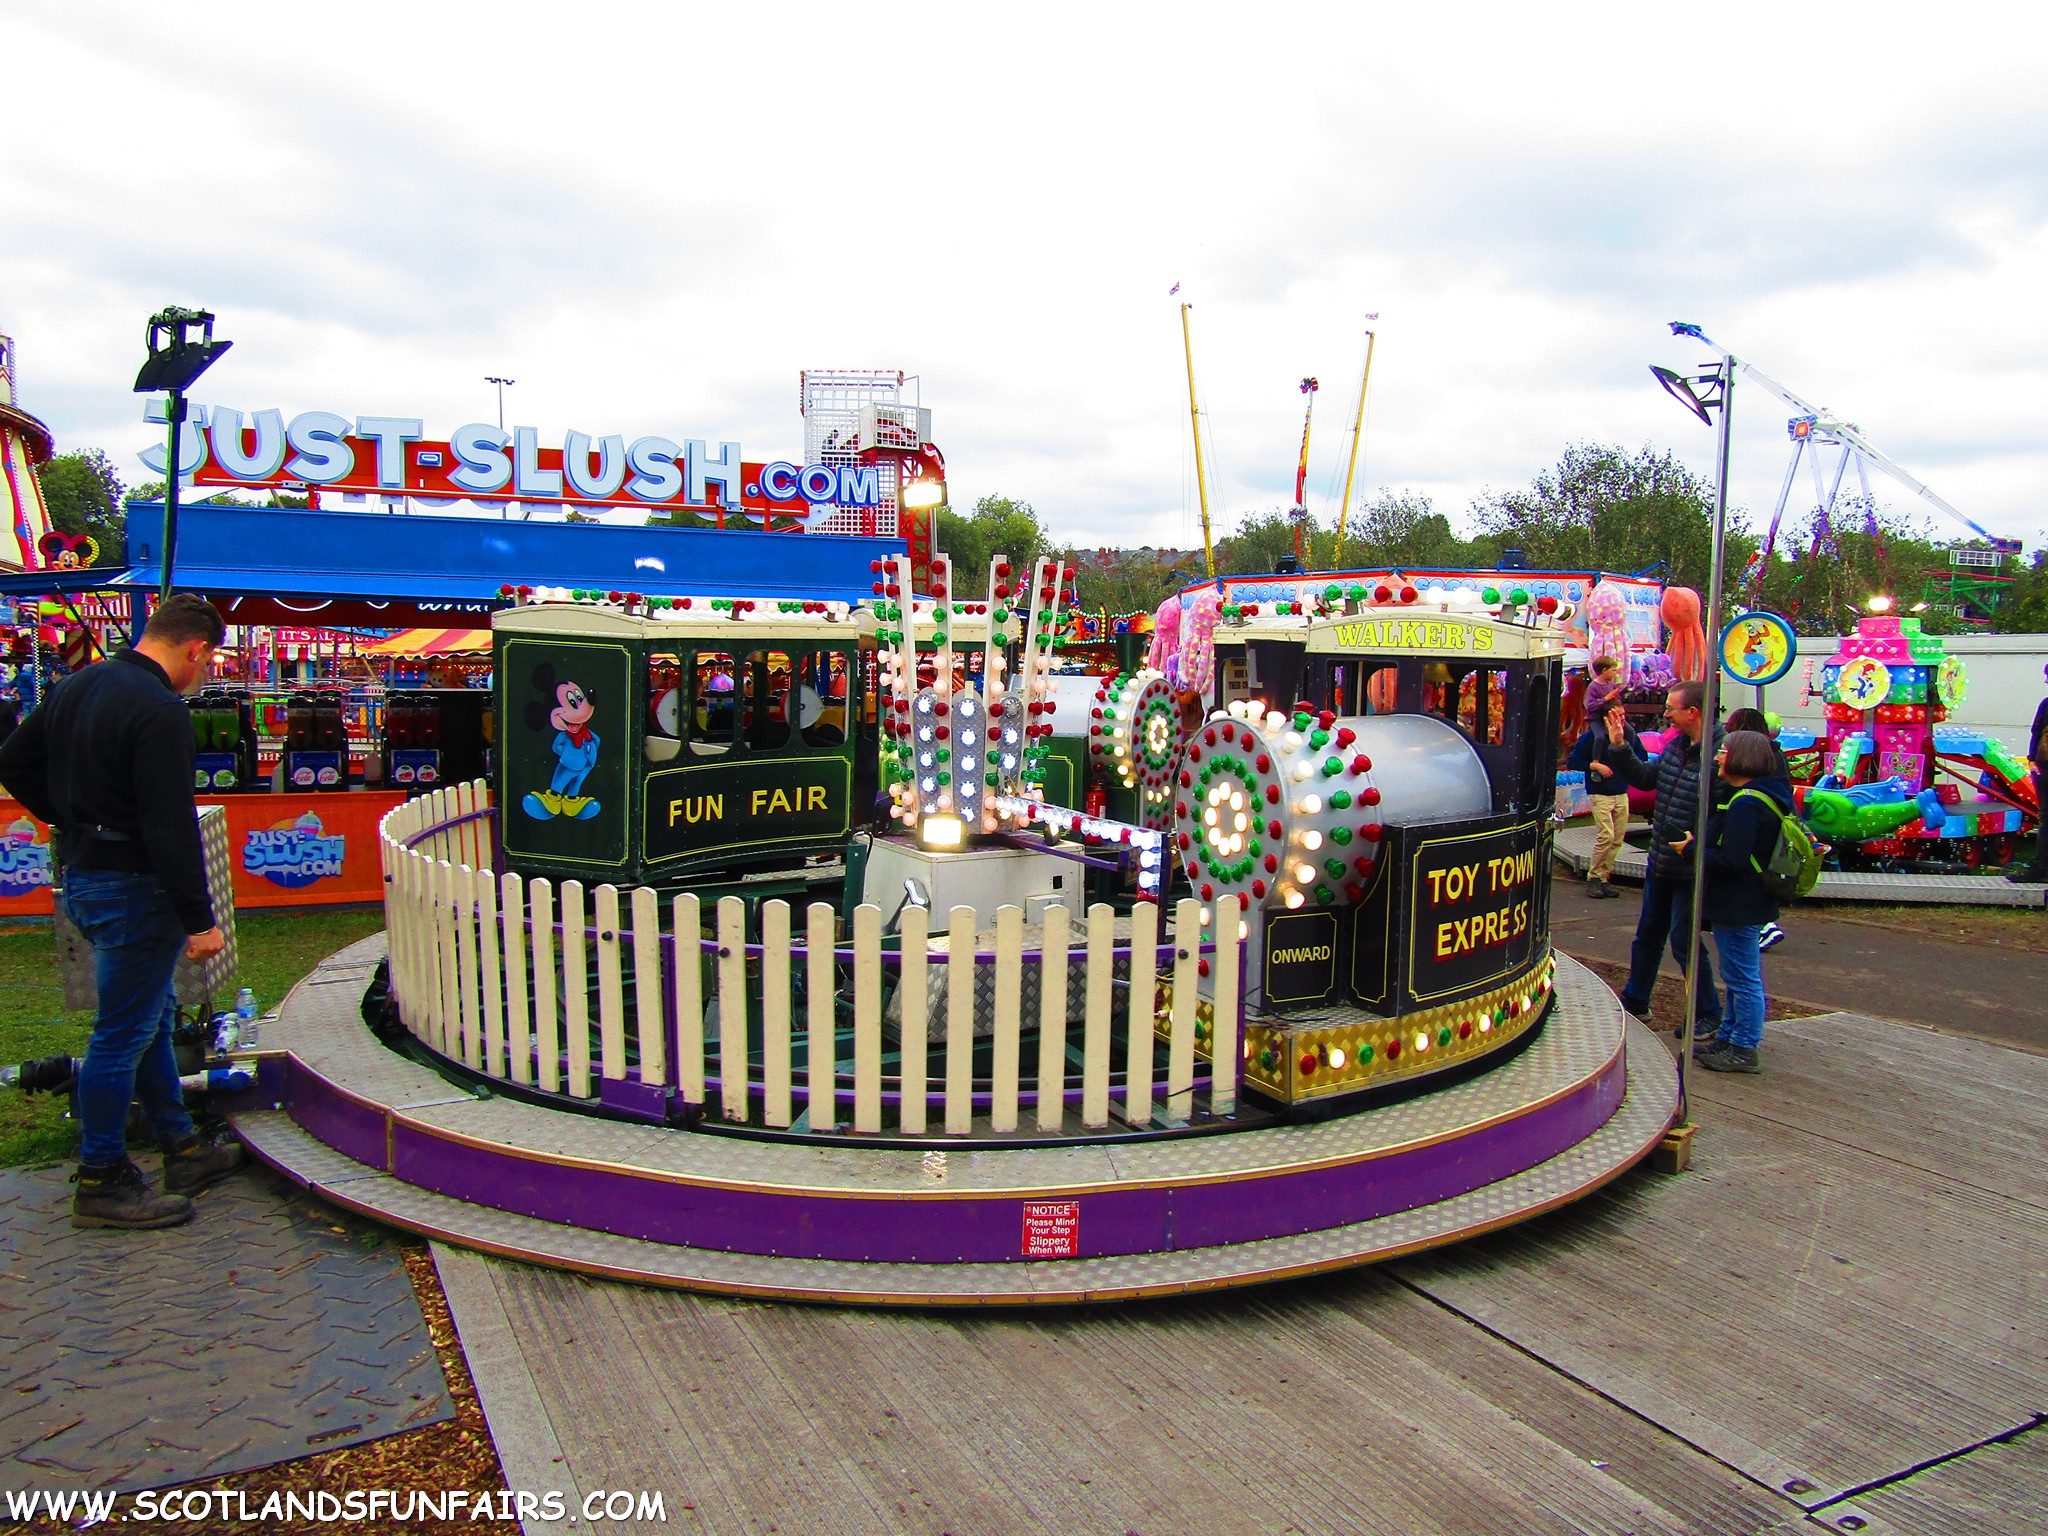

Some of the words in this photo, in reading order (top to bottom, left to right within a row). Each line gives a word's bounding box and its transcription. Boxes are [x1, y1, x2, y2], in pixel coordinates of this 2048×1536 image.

[1230, 583, 1299, 603] SCORE
[1566, 580, 1584, 603] 3
[281, 630, 311, 641] IT'S
[1334, 621, 1493, 650] WALKER'S
[668, 793, 723, 827] FUN
[751, 785, 828, 816] FAIR
[243, 837, 345, 868] SLUSH
[1427, 862, 1480, 904] TOY
[1487, 848, 1535, 892] TOWN
[1436, 900, 1528, 958] EXPRESS
[1271, 945, 1331, 964] ONWARD
[1032, 1205, 1071, 1215] NOTICE
[1026, 1218, 1053, 1226] Please
[1055, 1218, 1075, 1226] Mind
[1031, 1227, 1050, 1235] Your
[1051, 1226, 1070, 1235] Step
[1029, 1246, 1052, 1254] When
[1054, 1246, 1070, 1254] Wet
[1030, 1236, 1070, 1247] Slippery
